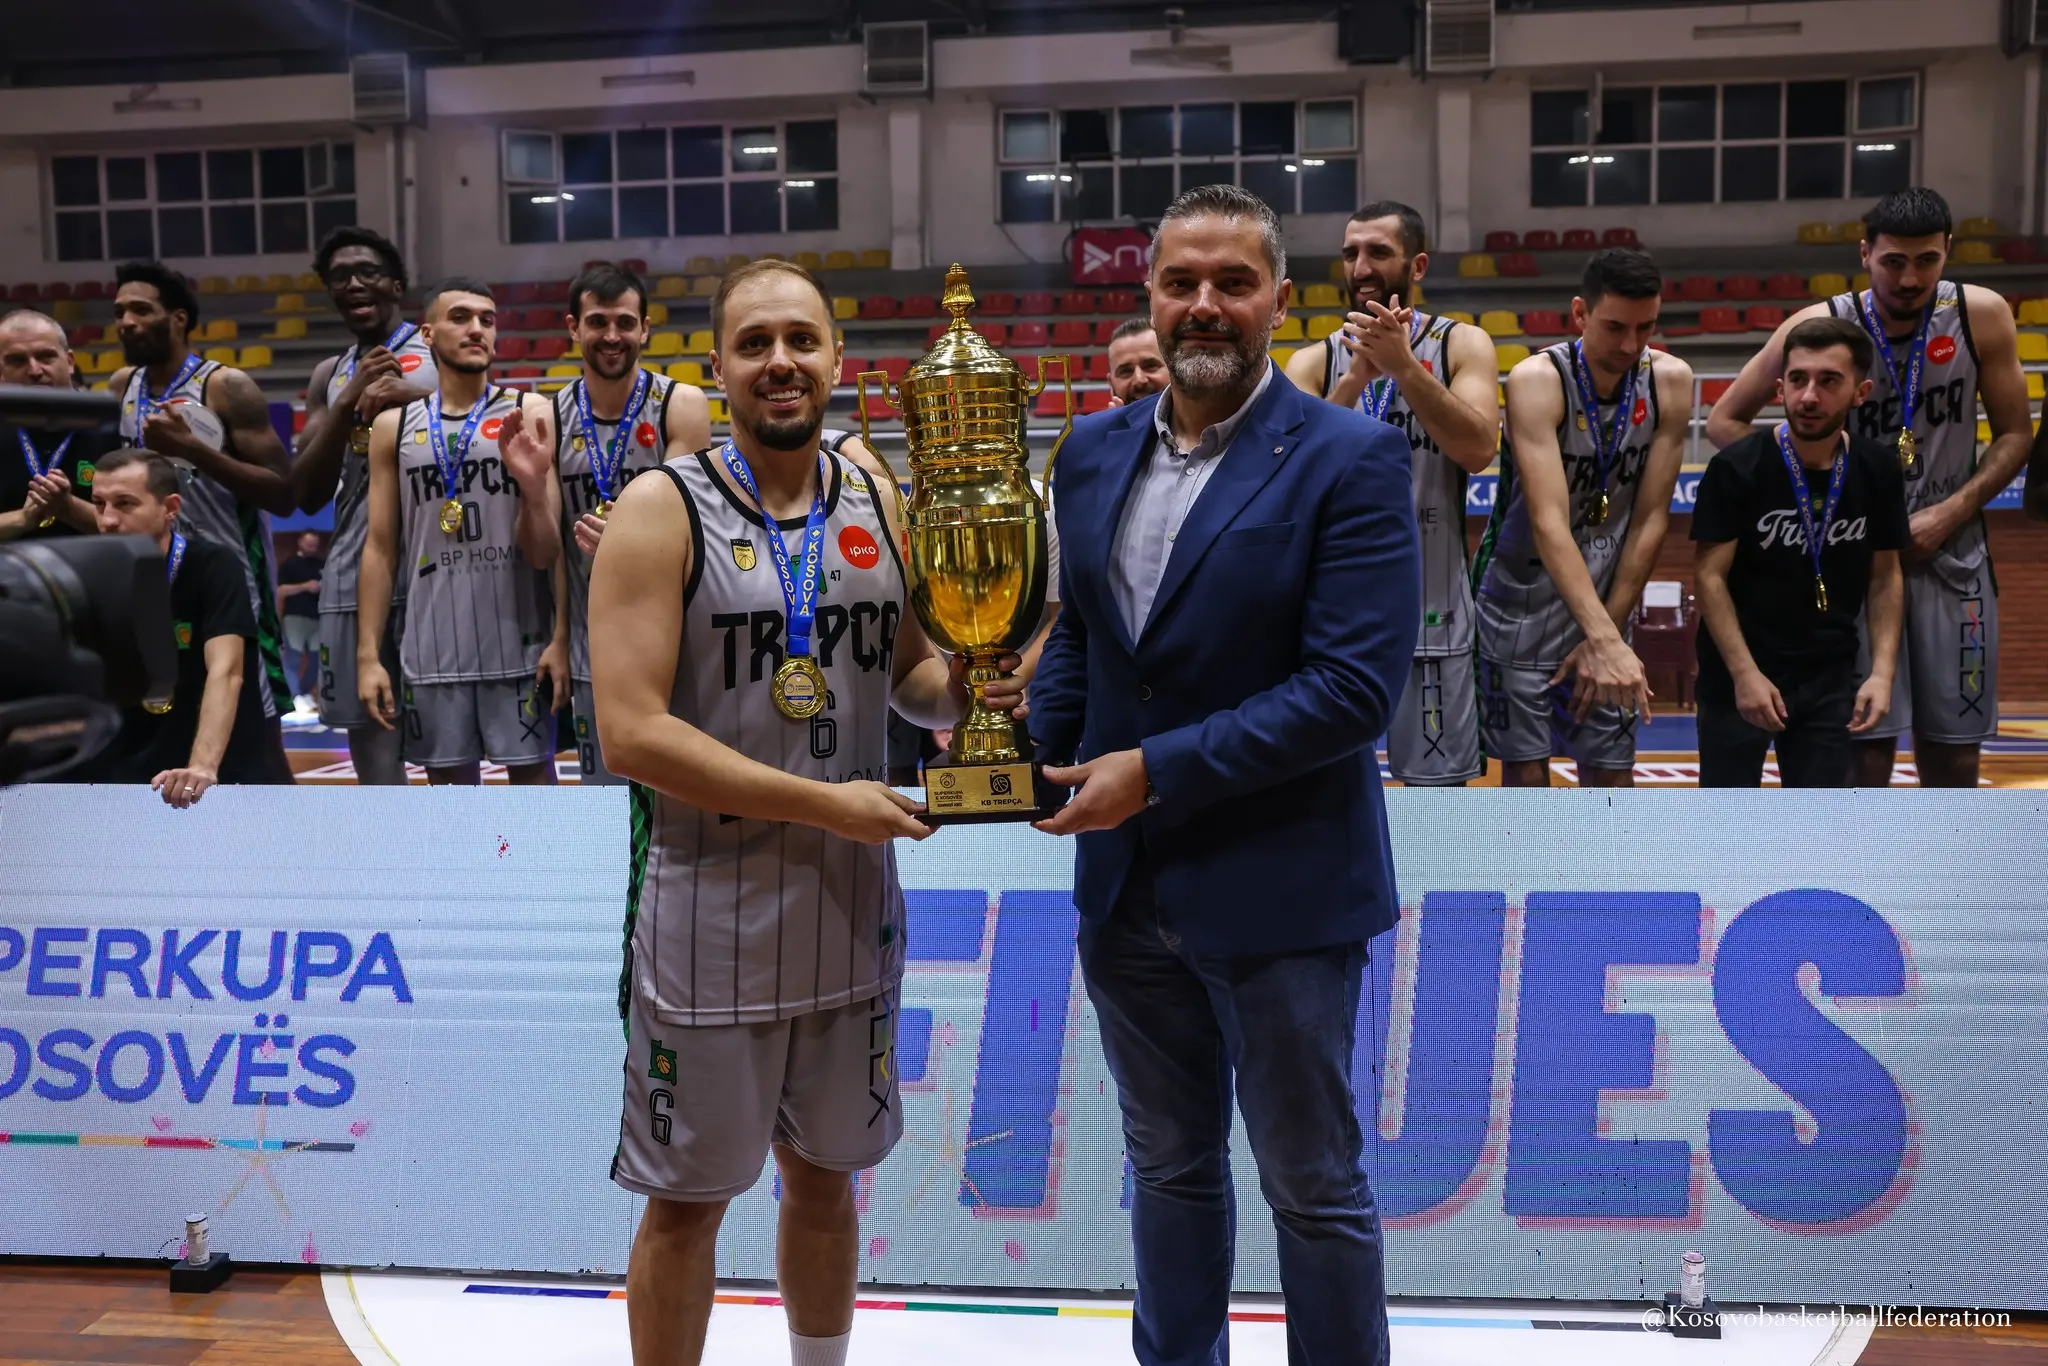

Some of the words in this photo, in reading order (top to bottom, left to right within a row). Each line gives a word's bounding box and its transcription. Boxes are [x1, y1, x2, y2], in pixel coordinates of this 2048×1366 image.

[441, 551, 463, 566] BP
[470, 545, 522, 563] HOM
[830, 570, 841, 581] 47
[799, 540, 819, 616] KOSOVA
[809, 689, 837, 760] 6
[993, 798, 1022, 806] TREPÇA
[649, 1088, 675, 1147] 6
